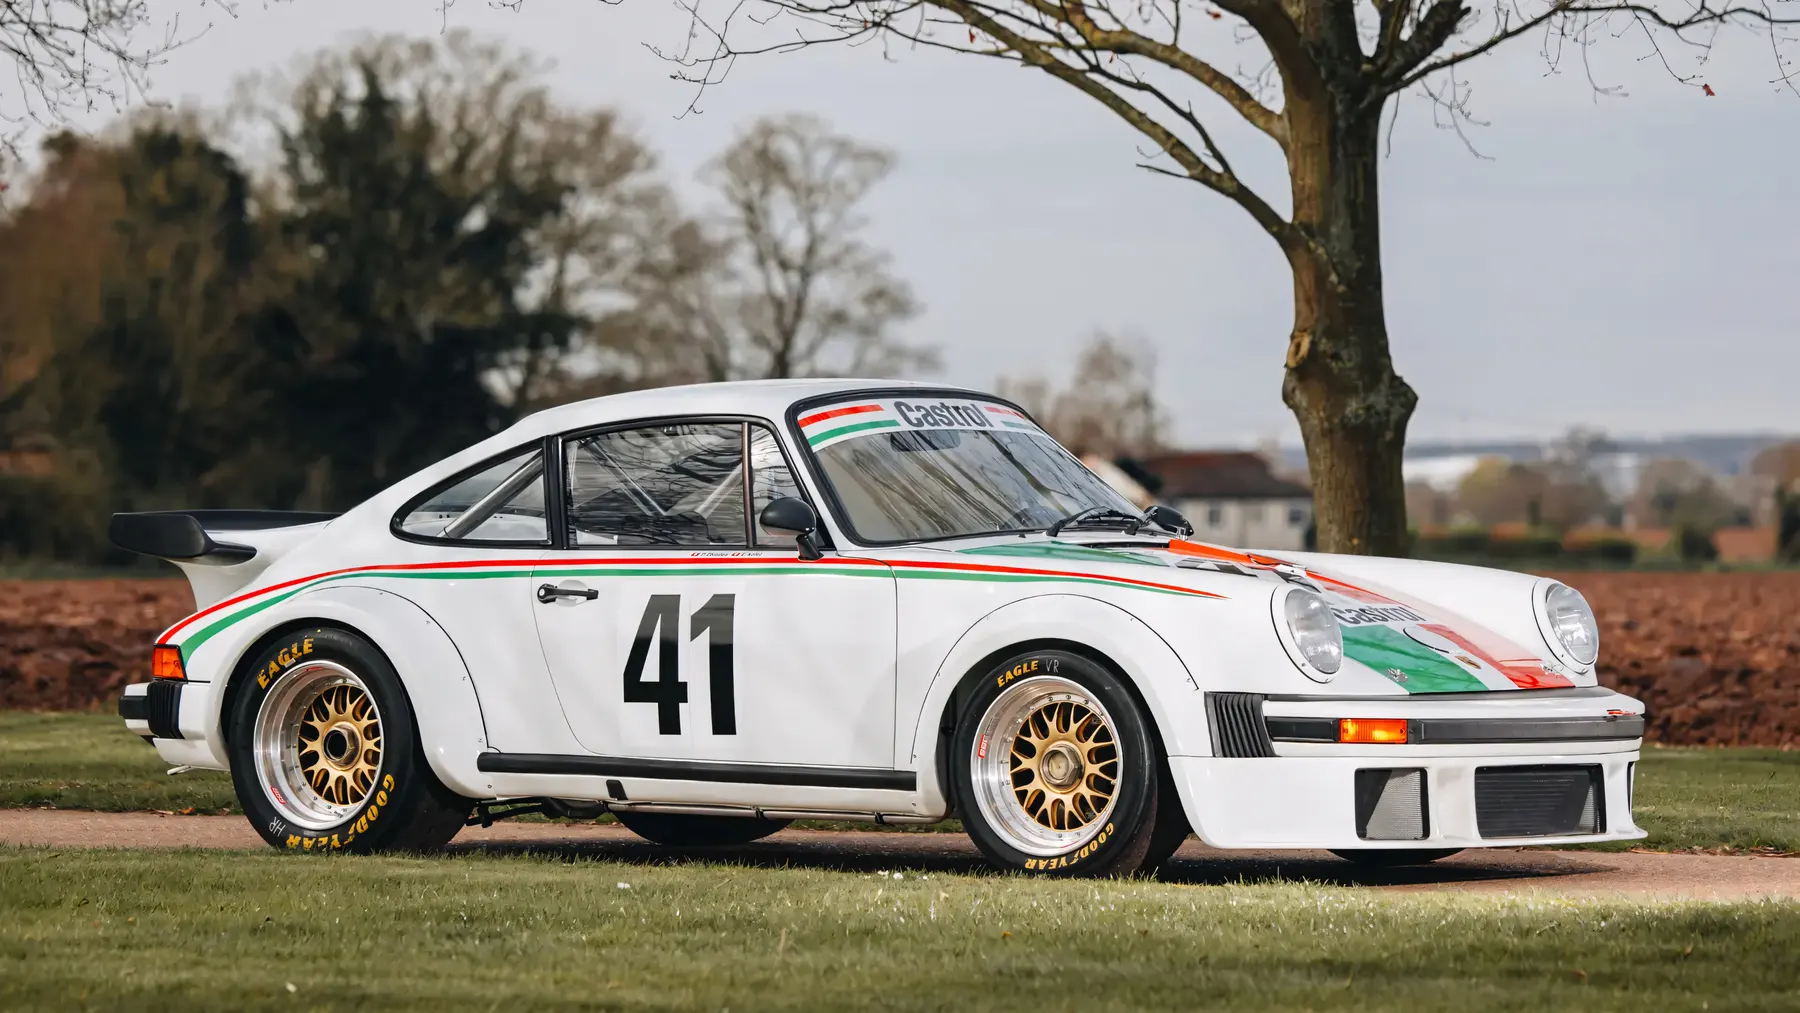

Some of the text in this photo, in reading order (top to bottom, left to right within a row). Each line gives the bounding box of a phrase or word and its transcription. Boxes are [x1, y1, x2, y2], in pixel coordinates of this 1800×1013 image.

[893, 400, 993, 428] Castrol
[1330, 606, 1426, 625] Castrol
[257, 638, 314, 689] EAGLE
[623, 593, 736, 736] 41
[997, 659, 1060, 688] EAGLE VR
[268, 816, 286, 837] HR
[1024, 822, 1115, 869] GOODYEAR
